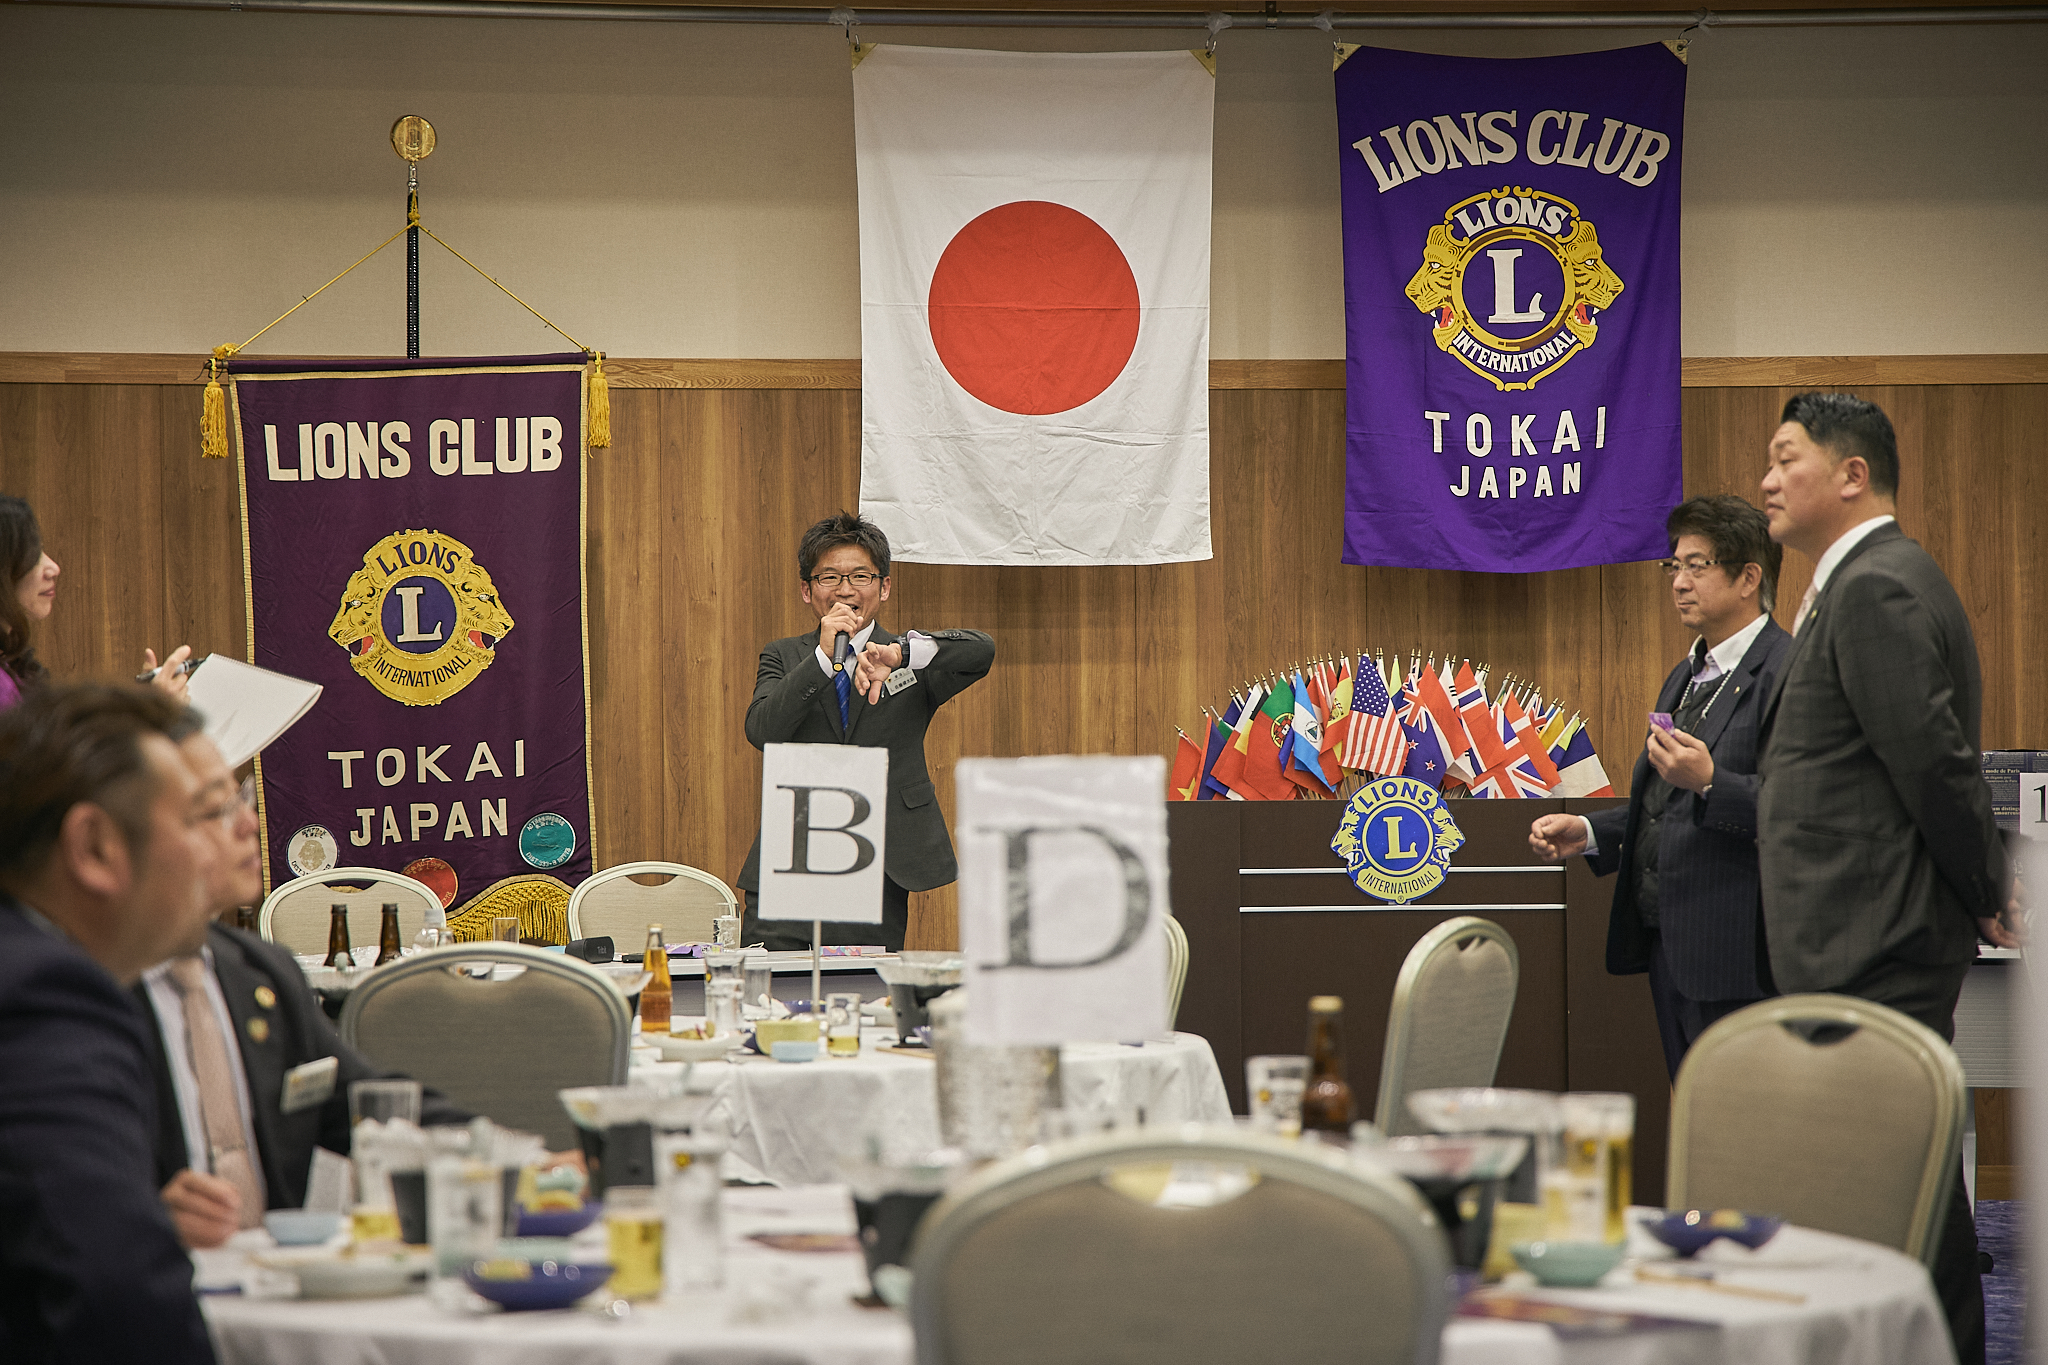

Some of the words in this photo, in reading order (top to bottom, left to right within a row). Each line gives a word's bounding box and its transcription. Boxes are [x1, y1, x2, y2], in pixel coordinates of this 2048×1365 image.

[1352, 109, 1518, 194] LIONS
[1526, 109, 1671, 188] CLUB
[1454, 196, 1569, 238] LIONS
[1486, 248, 1547, 324] L
[1452, 330, 1578, 373] INTERNATIONAL
[264, 420, 411, 481] LIONS
[429, 416, 563, 476] CLUB
[1424, 406, 1606, 458] TOKAI
[1449, 461, 1581, 499] JAPAN
[375, 541, 463, 577] LIONS
[395, 586, 443, 643] L
[373, 655, 472, 687] INTERNATIONAL
[327, 739, 525, 789] TOKAI
[1357, 781, 1434, 810] LIONS
[350, 798, 509, 847] JAPAN
[773, 784, 876, 876] B
[1382, 815, 1418, 860] L
[973, 822, 1151, 973] D
[1362, 870, 1438, 895] INTERNATIONAL
